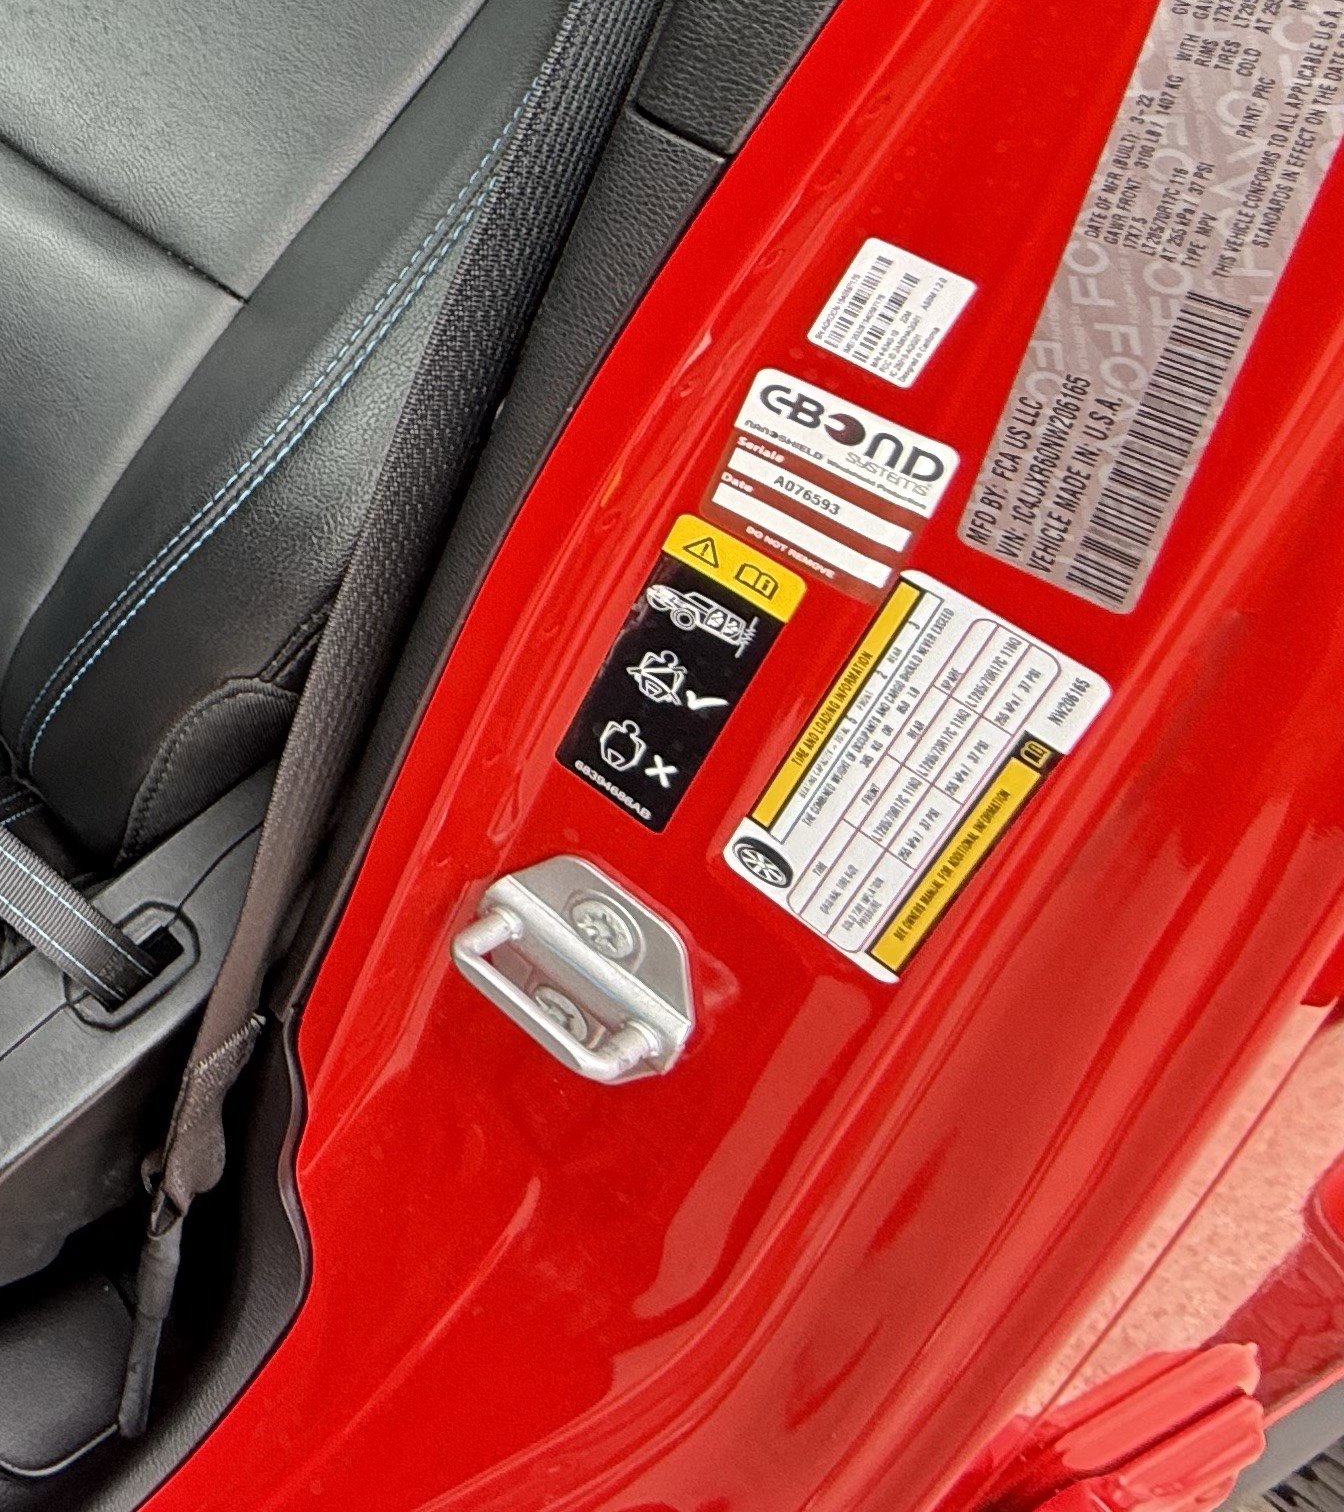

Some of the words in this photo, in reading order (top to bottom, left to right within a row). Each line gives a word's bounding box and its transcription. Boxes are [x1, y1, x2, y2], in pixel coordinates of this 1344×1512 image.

[1253, 20, 1273, 32] AT
[1172, 33, 1200, 62] WITH
[1192, 38, 1219, 66] RIMS
[1211, 39, 1242, 72] TIRES
[1234, 48, 1262, 76] COLD
[1164, 74, 1183, 89] KG
[1284, 42, 1328, 108] APPLICABLE
[1311, 84, 1337, 106] THE
[1274, 111, 1299, 130] ALL
[1304, 108, 1327, 124] ON
[1267, 134, 1289, 148] TO
[1286, 129, 1318, 166] EFFECT
[1133, 146, 1155, 168] 3100
[1193, 161, 1215, 179] PSI
[1195, 215, 1217, 235] MPV
[1251, 77, 1276, 98] PRC
[1101, 171, 1123, 192] MFR
[1187, 183, 1205, 193] 37
[1241, 150, 1282, 208] CONFORMS
[1280, 169, 1300, 181] IN
[1094, 197, 1112, 209] OF
[1251, 184, 1294, 247] STANDARDS
[1083, 212, 1107, 237] DATE
[1102, 213, 1128, 243] GAWR
[1222, 210, 1256, 251] VEHICLE
[1159, 250, 1177, 260] AT
[1211, 254, 1237, 278] THIS
[1012, 396, 1043, 425] LLC
[1081, 391, 1122, 440] U.S.A.
[1003, 426, 1032, 449] US
[1008, 373, 1091, 524] 1C4JJXR60NW206165
[990, 450, 1022, 480] FCA
[1071, 441, 1101, 466] IN:
[720, 471, 754, 494] Date
[844, 449, 929, 499] SYSTEMS
[1052, 466, 1091, 511] MADE
[772, 474, 842, 516] A076593
[981, 483, 1009, 509] BY:
[965, 510, 997, 543] MFD
[744, 525, 764, 540] DO
[762, 535, 788, 553] NOT
[785, 547, 836, 579] REMOVE
[995, 526, 1027, 558] VIN:
[1026, 511, 1071, 572] VEHICLE
[790, 747, 809, 766] TIRE
[801, 731, 820, 750] AND
[812, 700, 840, 734] LOADING
[832, 649, 873, 702] INFORMATION
[1047, 676, 1091, 725] NW206165
[971, 788, 1011, 833] INFORMATION
